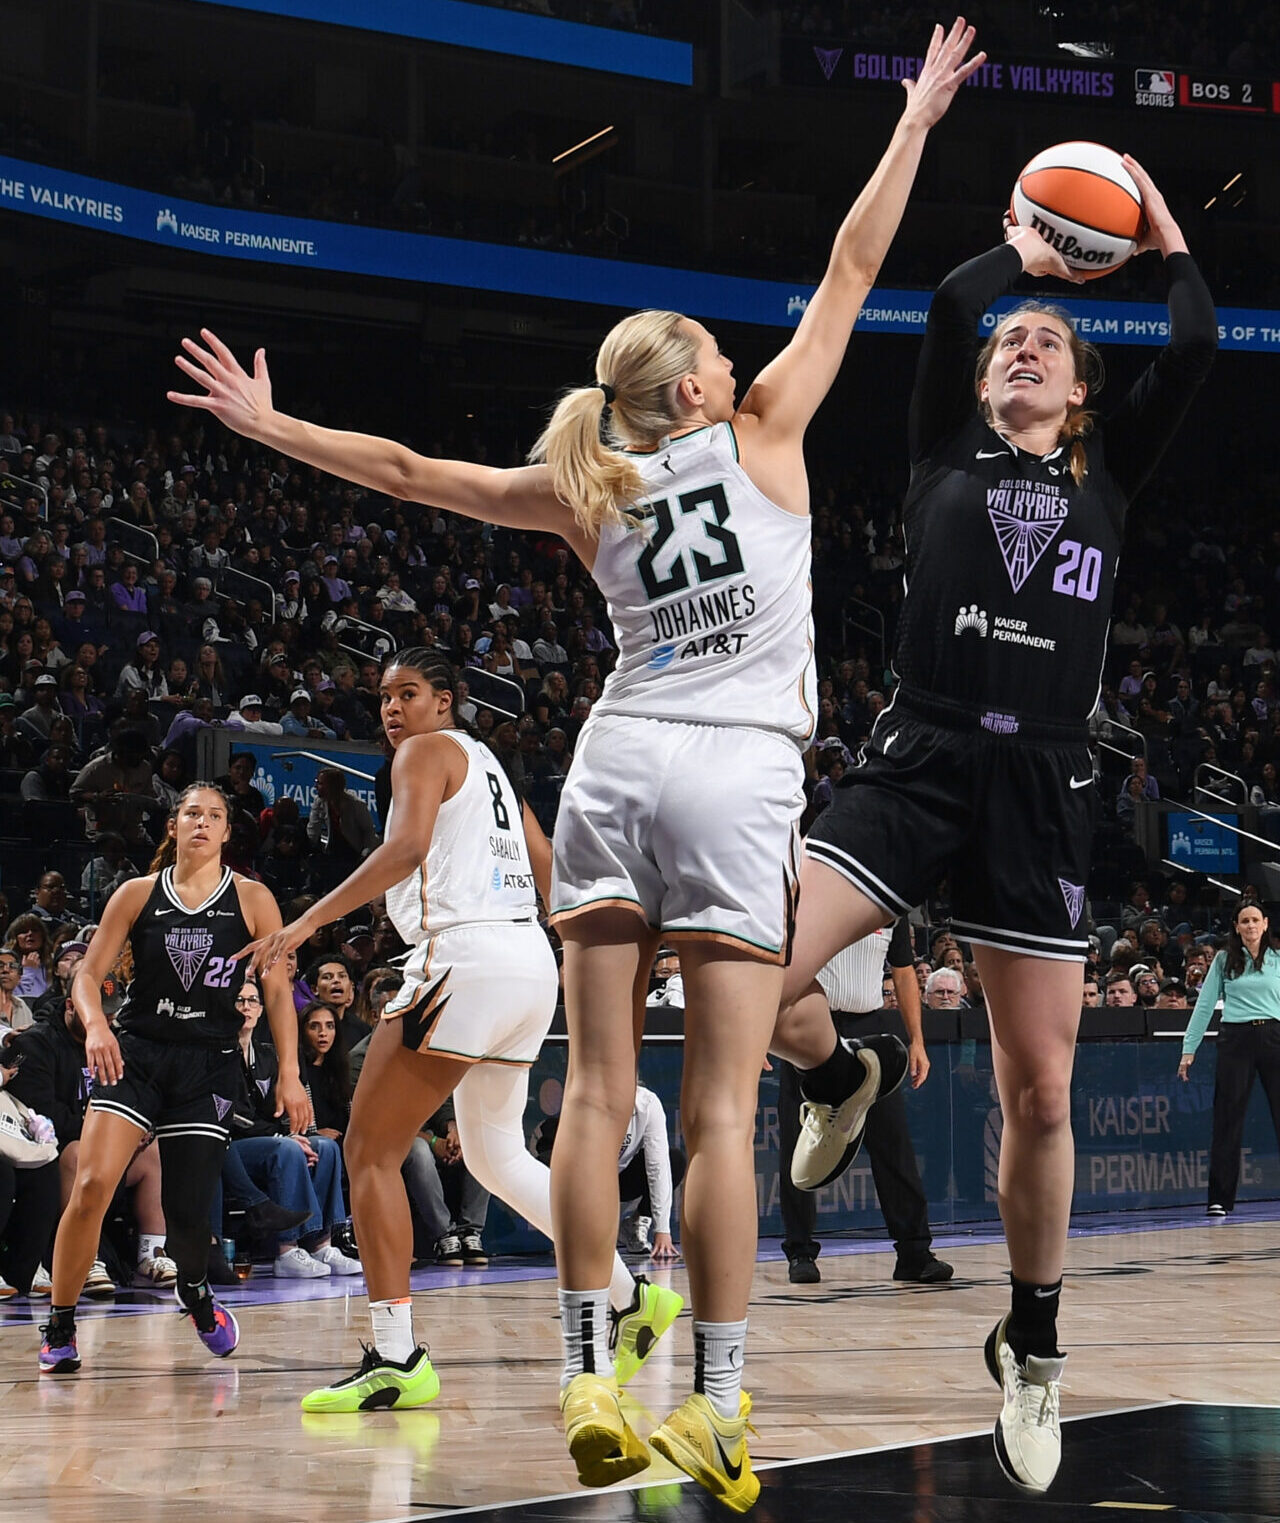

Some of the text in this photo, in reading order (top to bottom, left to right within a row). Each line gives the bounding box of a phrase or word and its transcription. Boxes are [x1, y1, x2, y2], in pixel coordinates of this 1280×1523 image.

[964, 63, 1003, 89] ATE
[1010, 65, 1115, 97] VALKYRIES
[1191, 82, 1253, 103] BOS 2
[1135, 92, 1175, 108] SCORES
[30, 185, 123, 223] VALKYRIES
[181, 221, 316, 256] KAISER PERMANENTE
[1030, 213, 1115, 264] Wilson
[858, 308, 928, 324] PERMANEN
[1070, 317, 1119, 334] TEAM
[1124, 319, 1227, 339] PHYSIS
[1231, 325, 1256, 341] OF
[999, 479, 1060, 496] GOLDEN STATE
[986, 488, 1069, 521] VALKYRIES
[622, 482, 746, 601] 23
[1052, 539, 1103, 602] 20
[651, 585, 756, 643] JOHANNÈS
[994, 616, 1028, 632] KAISER
[680, 633, 749, 659] AT&T
[992, 629, 1056, 651] PERMANENTE
[284, 784, 319, 807] KAIS
[485, 770, 510, 831] 8
[489, 835, 521, 861] SABALLY
[504, 873, 534, 889] AT&T
[164, 933, 214, 950] VALKYRIES
[203, 957, 238, 988] 22
[1089, 1095, 1170, 1136] KAISER
[1090, 1147, 1253, 1195] PERMANEE
